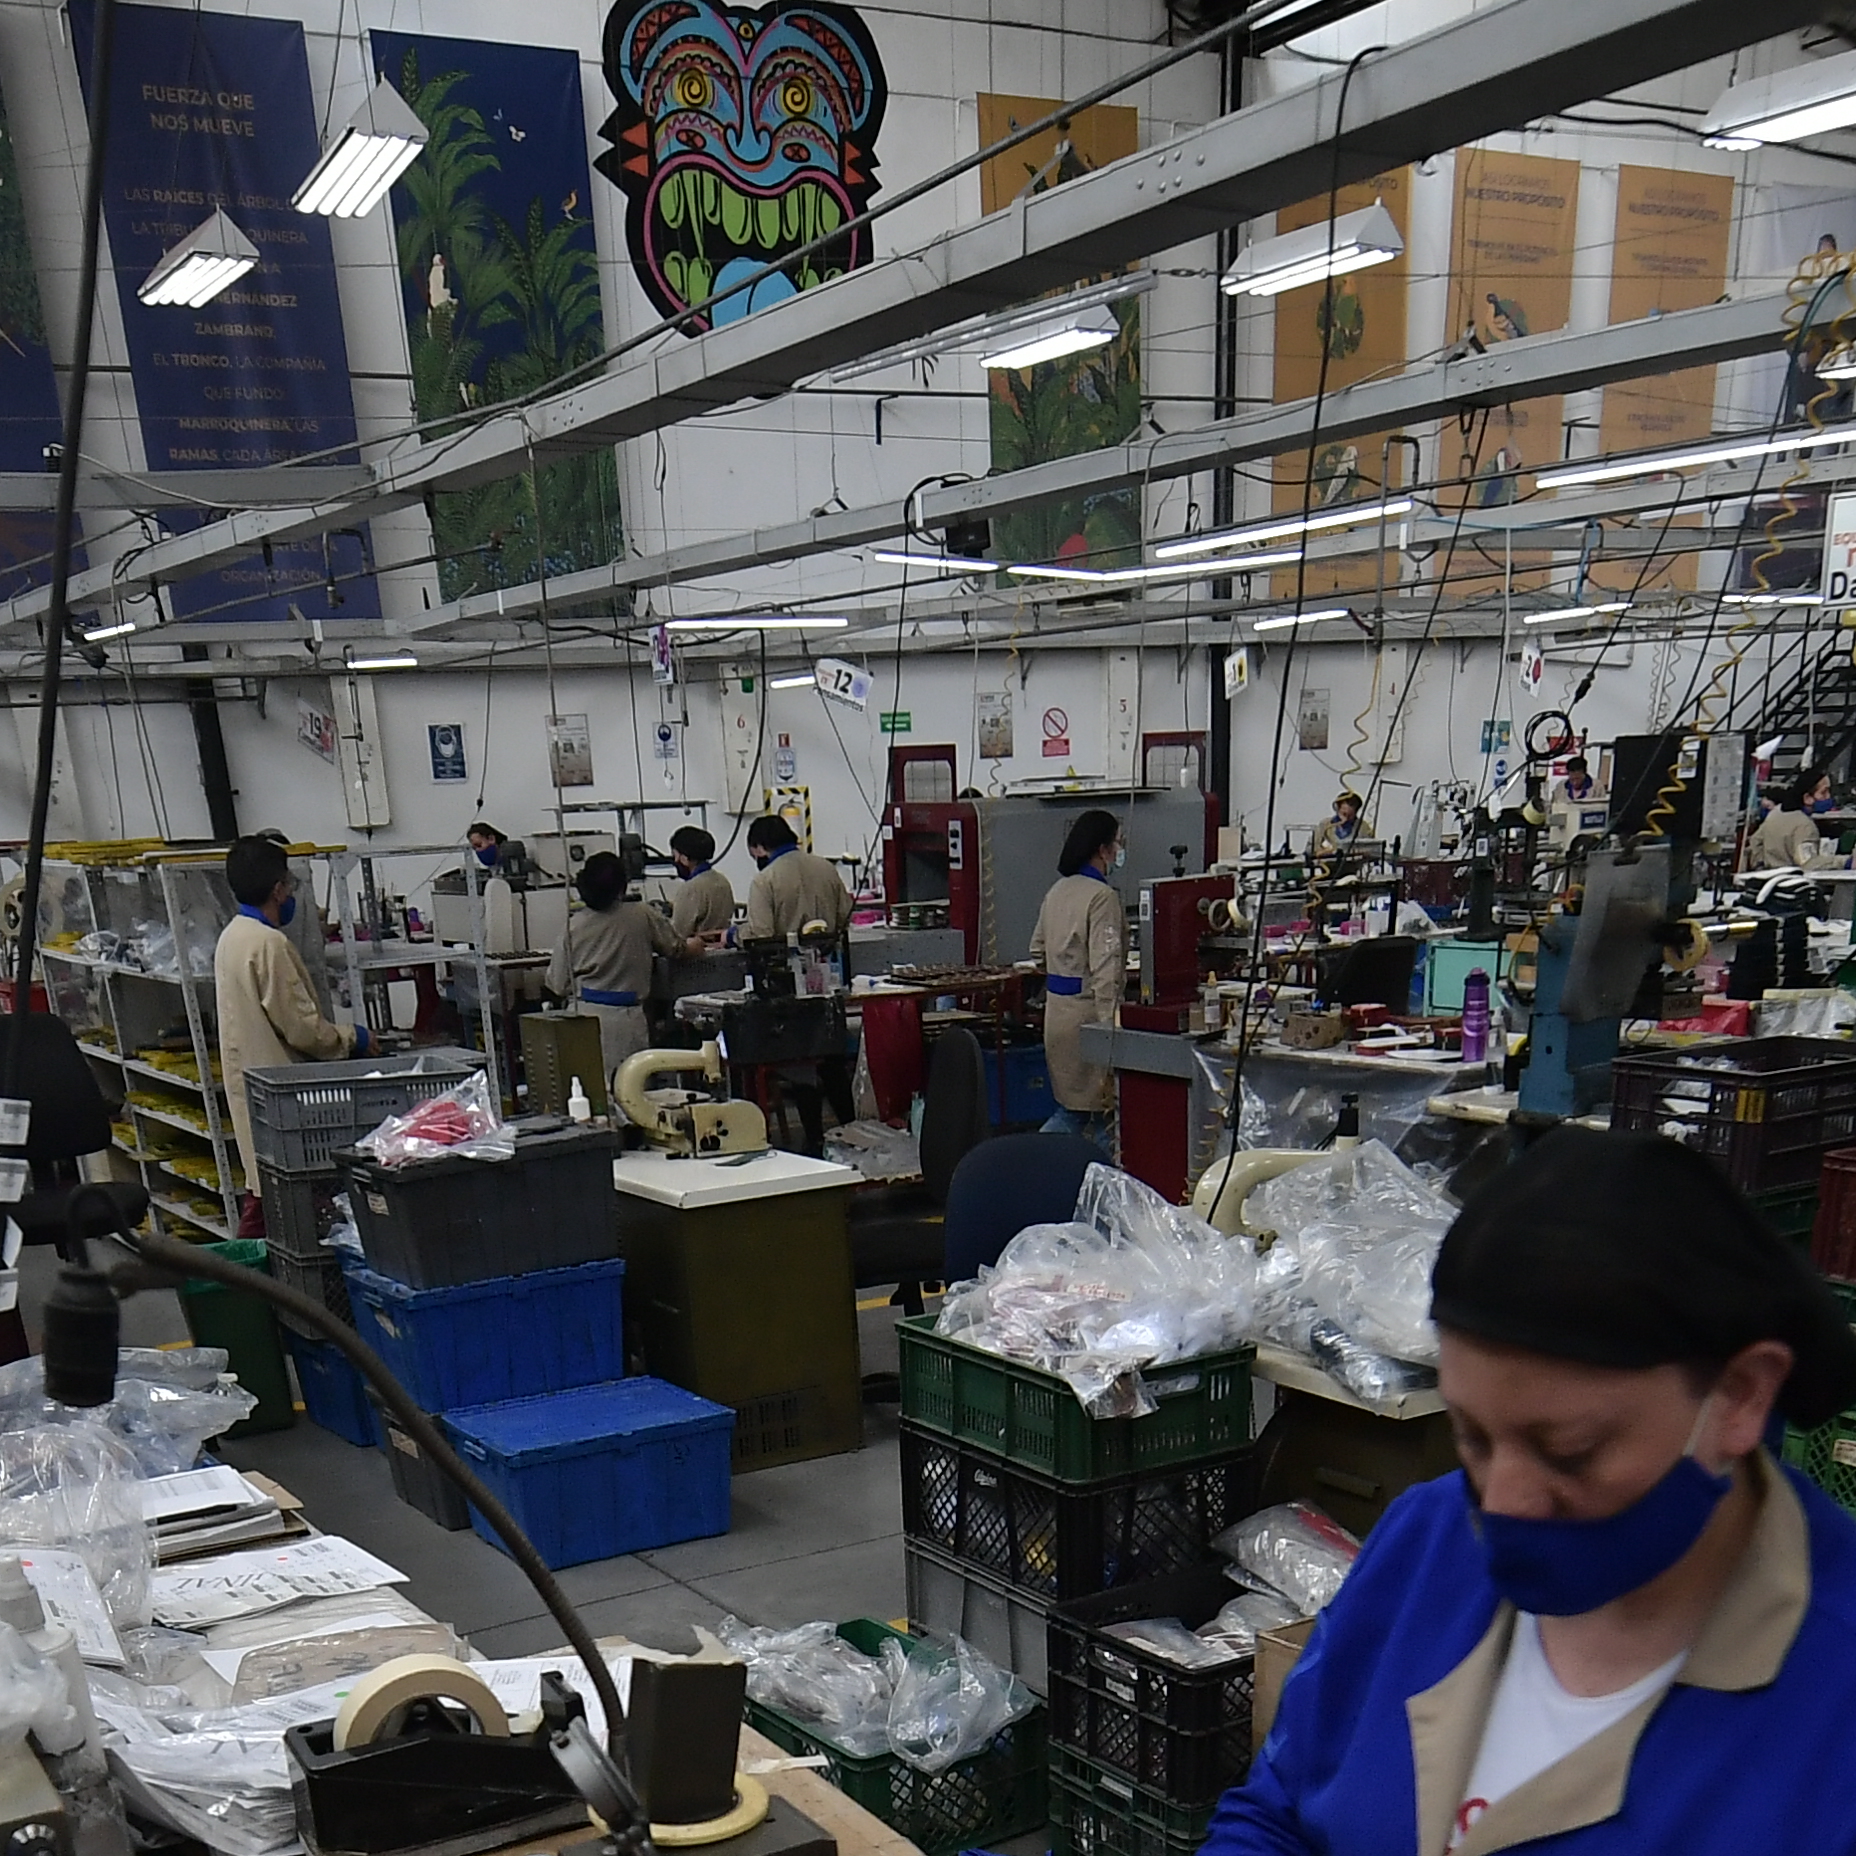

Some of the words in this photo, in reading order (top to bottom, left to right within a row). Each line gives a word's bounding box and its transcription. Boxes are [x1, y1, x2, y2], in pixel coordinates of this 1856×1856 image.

[142, 85, 212, 106] FUERZA
[217, 92, 255, 111] QUE
[150, 113, 188, 131] NOS
[194, 117, 255, 137] MUEVE
[124, 188, 149, 201] LAS
[247, 226, 309, 244] QUINERA
[833, 668, 854, 695] 12
[308, 712, 323, 739] 19
[736, 715, 746, 729] 6
